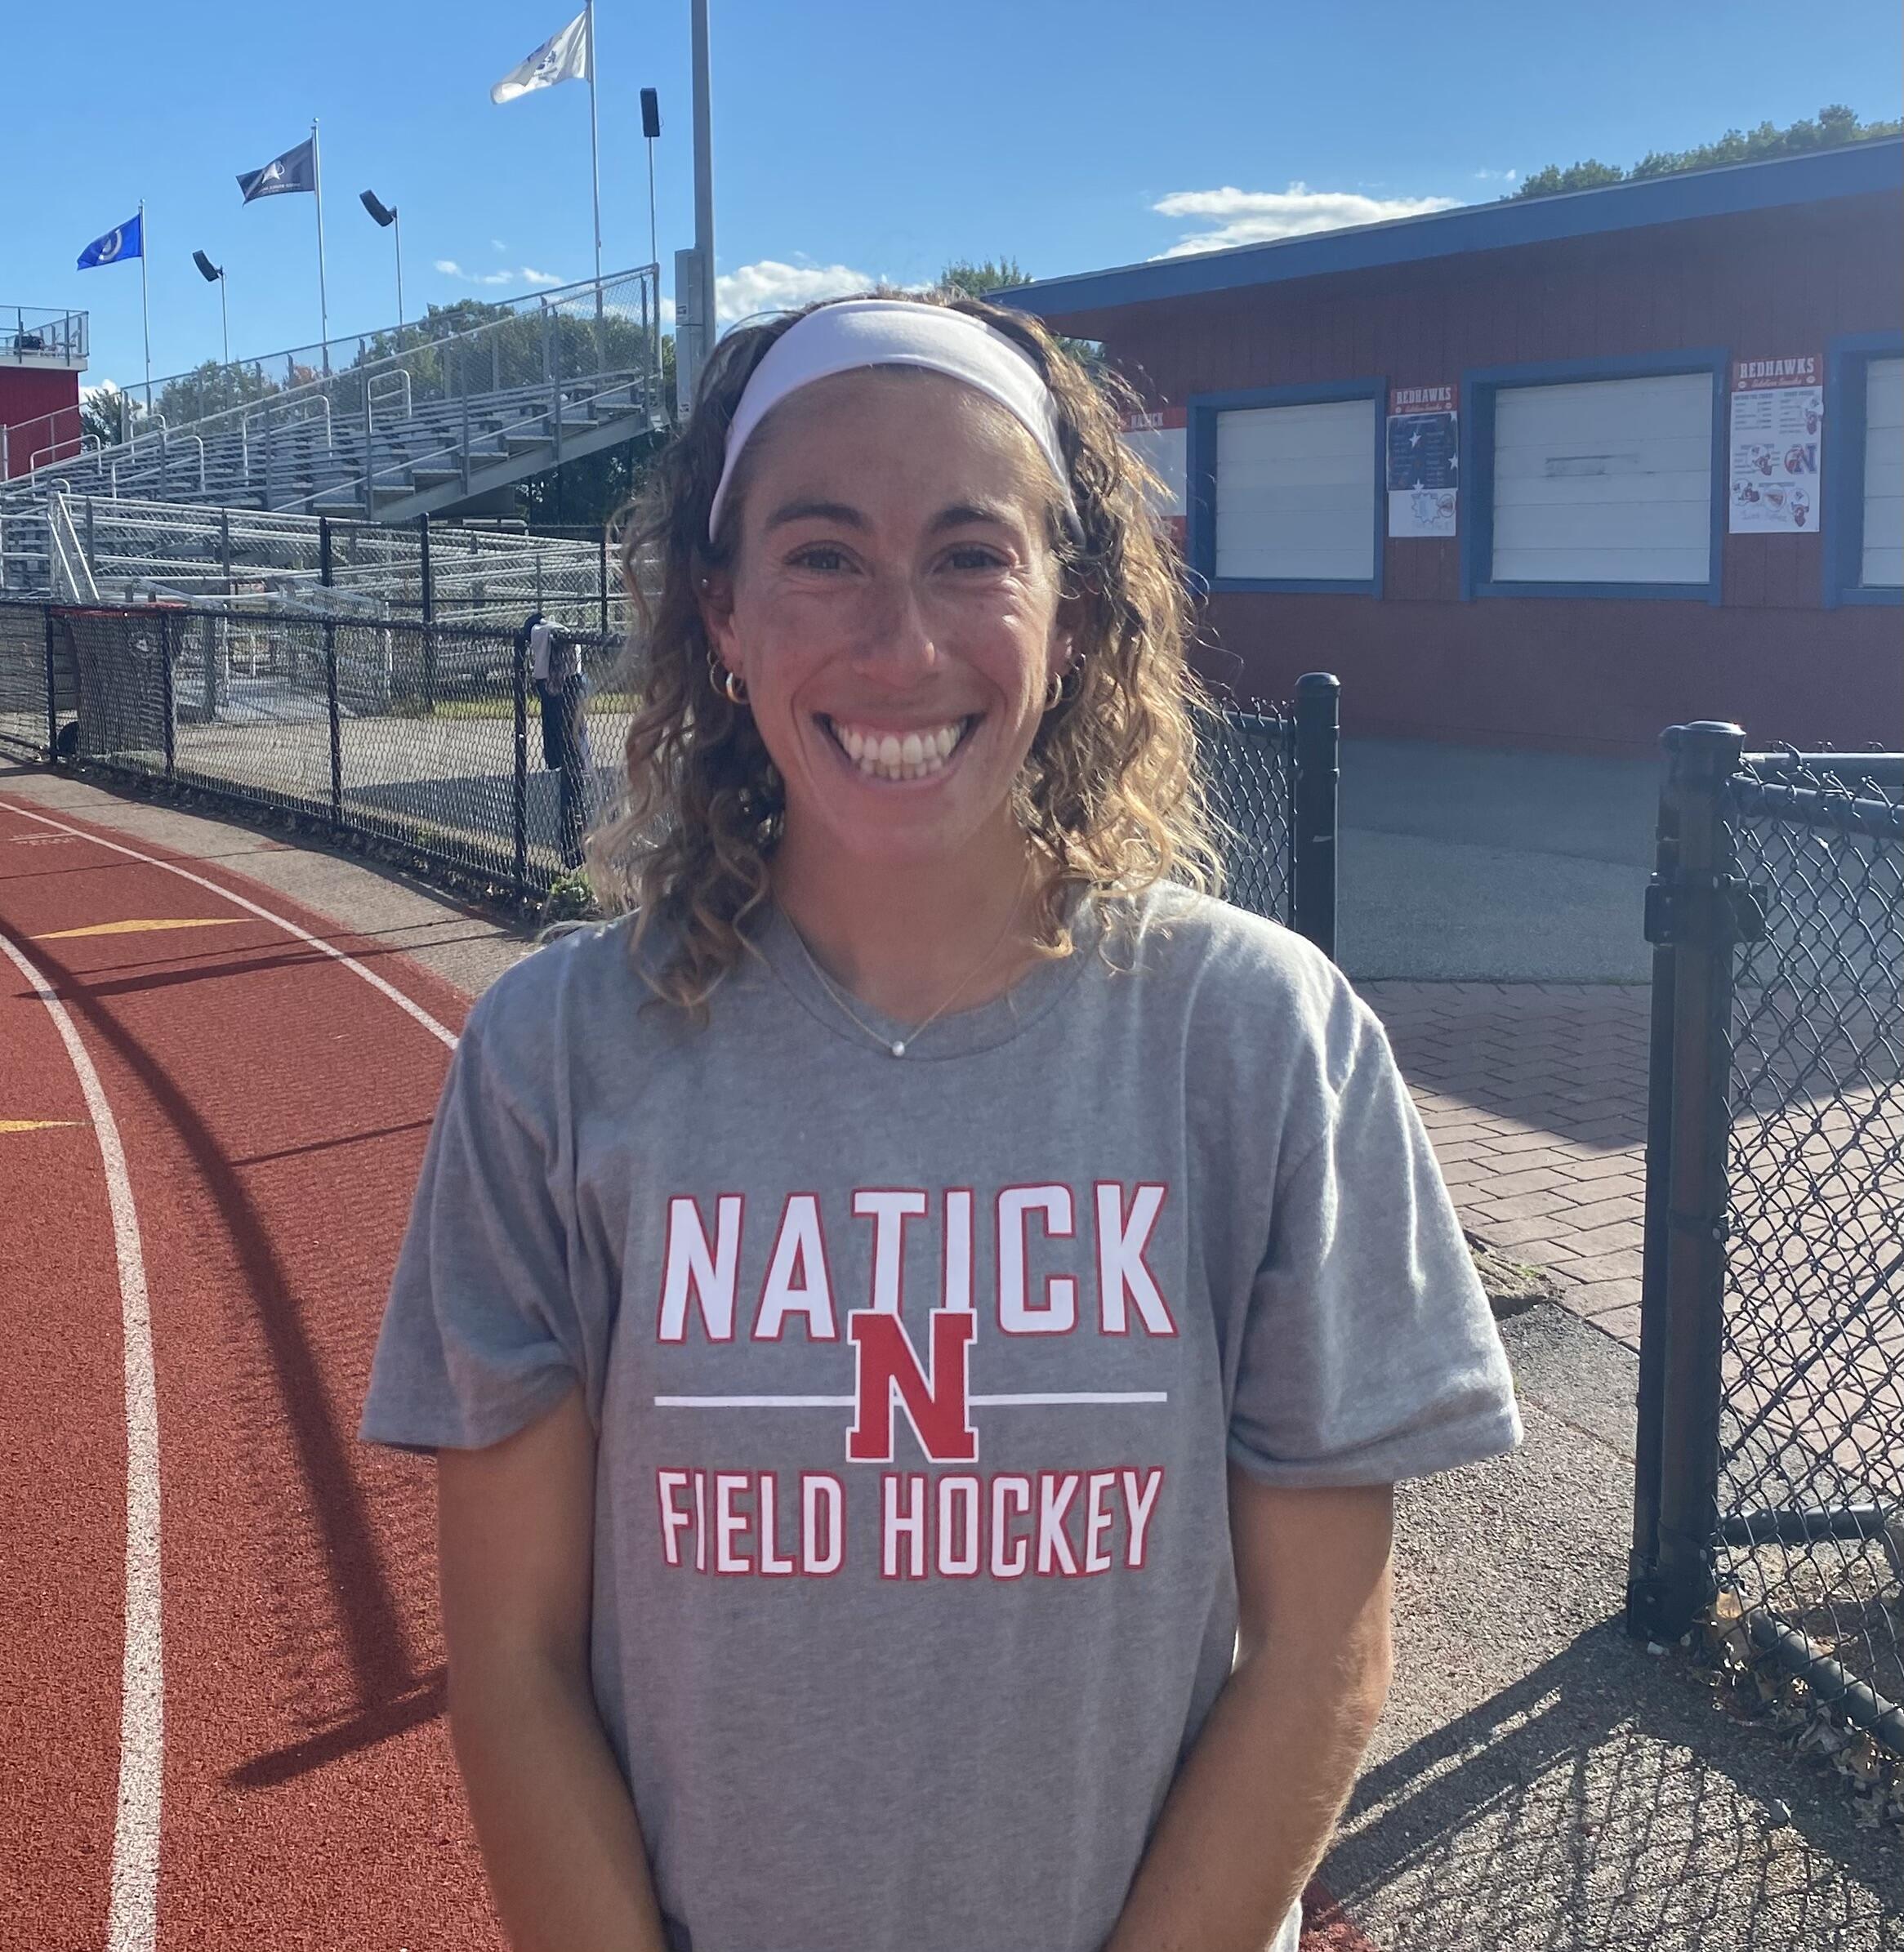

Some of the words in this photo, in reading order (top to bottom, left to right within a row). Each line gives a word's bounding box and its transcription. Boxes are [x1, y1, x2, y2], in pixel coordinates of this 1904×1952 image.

[1397, 387, 1451, 405] REDHAWKS
[1740, 358, 1814, 378] REDHAWKS
[657, 1180, 1179, 1344] NATICK
[846, 1308, 979, 1463] N
[657, 1468, 846, 1579] FIELD
[881, 1465, 1166, 1581] HOCKEY
